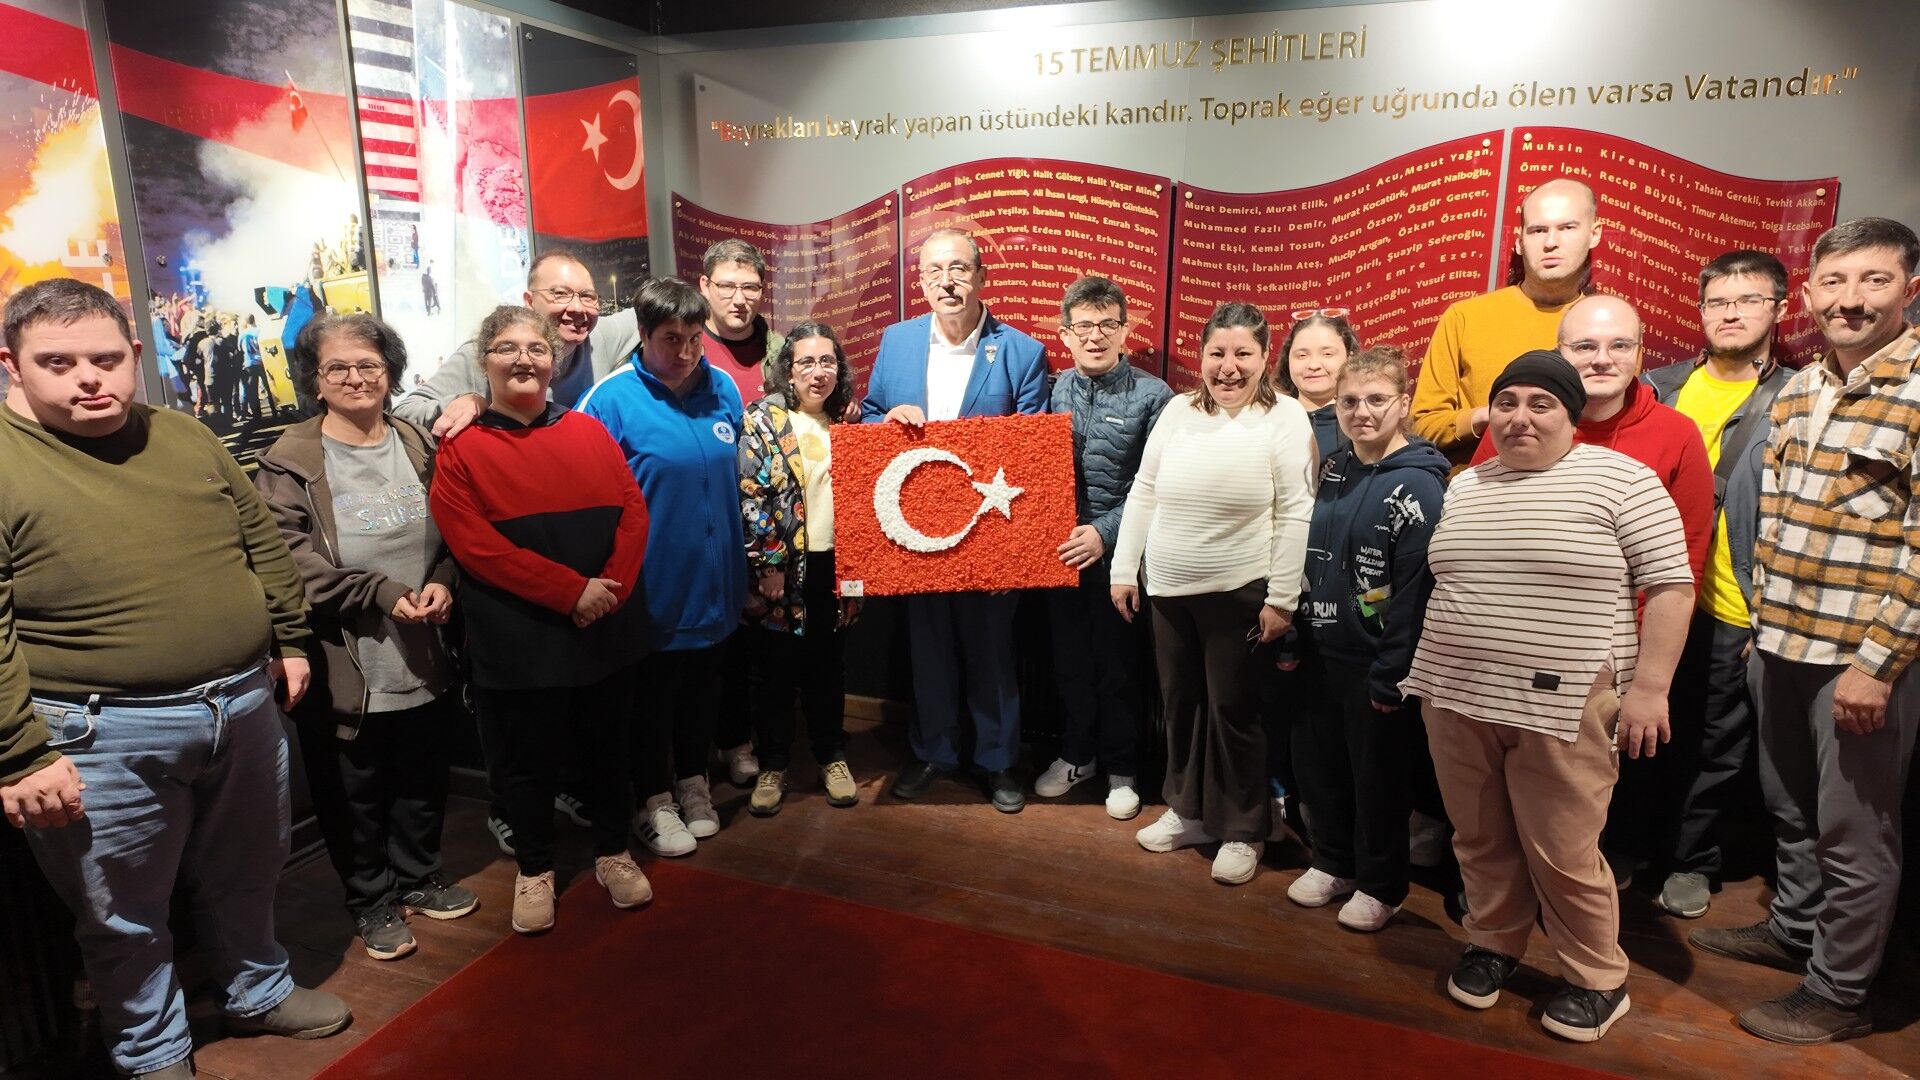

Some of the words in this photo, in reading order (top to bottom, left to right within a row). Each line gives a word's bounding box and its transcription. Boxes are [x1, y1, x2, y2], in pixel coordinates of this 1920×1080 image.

[1034, 51, 1064, 75] 15
[1070, 40, 1202, 74] TEMMUZ
[1210, 24, 1367, 72] ŞEHİTLERİ
[824, 112, 898, 142] bayrak
[904, 113, 972, 142] yapan
[980, 104, 1098, 131] üstündeki
[1105, 100, 1192, 125] kandır.
[1201, 94, 1292, 125] Toprak
[1299, 94, 1363, 122] eğer
[1372, 90, 1498, 118] uğrunda
[1507, 83, 1576, 109] ölen
[1586, 81, 1675, 105] varsa
[910, 182, 952, 201] Celaleddin
[976, 170, 1004, 181] Cennet
[1008, 169, 1030, 179] Yiğit,
[1033, 170, 1053, 179] Halit
[1056, 172, 1084, 184] Gülser,
[1087, 176, 1107, 186] Halit
[1110, 180, 1133, 191] Yaşar
[1136, 185, 1160, 198] Mine,
[1185, 200, 1215, 213] Murat
[1219, 204, 1261, 215] Demirci,
[1266, 203, 1297, 213] Murat
[1334, 184, 1371, 205] Mesut
[1376, 170, 1403, 187] Acu,
[1405, 157, 1444, 176] Mesut
[1451, 148, 1494, 164] Yağan,
[1522, 141, 1583, 153] Muhsin
[1600, 148, 1690, 189] Kiremitçi,
[1695, 180, 1723, 197] Tahsin
[1766, 196, 1794, 207] Tevhit
[1796, 196, 1826, 207] Akkan,
[1045, 188, 1065, 199] İhsan
[1091, 196, 1120, 208] Hüseyin
[1122, 202, 1159, 218] Güntekin,
[1184, 219, 1247, 234] Muhammed
[1289, 219, 1326, 231] Demir,
[1332, 208, 1360, 225] Murat
[1363, 189, 1409, 212] Kocatürk,
[1411, 178, 1441, 194] Murat
[1520, 162, 1554, 172] Ömer
[1560, 162, 1592, 178] İpek,
[1600, 171, 1637, 191] Recep
[1645, 185, 1687, 210] Büyük,
[1691, 204, 1716, 219] Timur
[1718, 211, 1757, 230] Aktemur,
[1761, 220, 1784, 232] Tolga
[700, 220, 737, 234] Halisdemir,
[911, 223, 932, 236] Cuma
[956, 209, 995, 222] Beytullah
[997, 206, 1029, 216] Yeşilay,
[1033, 205, 1065, 217] İbrahim
[1069, 211, 1099, 224] Yılmaz,
[1103, 217, 1131, 230] Emrah
[1134, 224, 1158, 237] Sapa,
[1183, 238, 1215, 250] Kemal
[1251, 243, 1284, 253] Kemal
[1289, 240, 1324, 251] Tosun,
[1330, 226, 1362, 245] Özcan
[1367, 211, 1402, 231] Özsoy,
[1408, 197, 1441, 215] Özgür
[1447, 189, 1490, 205] Gençer,
[1601, 194, 1631, 211] Resul
[1633, 204, 1685, 232] Kaptancı,
[1688, 228, 1726, 246] Türkan
[1733, 240, 1781, 254] Türkmen
[972, 225, 1005, 237] Mehmet
[1032, 226, 1062, 236] Erdem
[1065, 229, 1094, 241] Diker,
[1096, 234, 1124, 246] Erhan
[1128, 241, 1158, 256] Dural,
[1182, 257, 1223, 272] Mahmut
[1253, 262, 1292, 272] İbrahim
[1296, 258, 1323, 270] Ateş,
[1399, 218, 1435, 237] Özkan
[1441, 209, 1487, 224] Özendi,
[1630, 226, 1681, 255] Kaymakçı,
[1685, 247, 1710, 265] Sevgi
[873, 260, 891, 270] Acar,
[1032, 244, 1057, 253] Fatih
[1062, 248, 1096, 260] Dalgıç,
[1101, 253, 1125, 265] Fazıl
[1130, 260, 1157, 274] Gürs,
[1181, 275, 1221, 290] Mehmet
[1226, 281, 1251, 292] Şefik
[1387, 243, 1423, 262] Şuayip
[1428, 228, 1485, 247] Seferoğlu,
[1608, 241, 1637, 259] Varol
[1642, 253, 1678, 276] Tosun,
[1031, 260, 1054, 270] İhsan
[1112, 273, 1156, 293] Kaymakçı,
[1031, 280, 1060, 289] Askeri
[1180, 293, 1214, 307] Lokman
[1291, 299, 1320, 310] Konuş,
[1326, 282, 1372, 304] Yunus
[1386, 261, 1425, 282] Emre
[1440, 251, 1483, 263] Ezer,
[1416, 275, 1445, 289] Yusuf
[1628, 274, 1675, 298] Ertürk,
[1003, 296, 1028, 305] Polat,
[1363, 307, 1406, 327] Tecimen,
[1412, 295, 1438, 309] Yıldız
[1636, 298, 1672, 319] Yaşar,
[1676, 314, 1700, 332] Vedat
[1031, 332, 1057, 340] Hasan
[1177, 347, 1198, 359] Lütfi
[1364, 325, 1409, 347] Aydoğdu,
[1672, 335, 1696, 354] Suat
[1360, 546, 1382, 558] WATER
[1313, 601, 1338, 618] RUN
